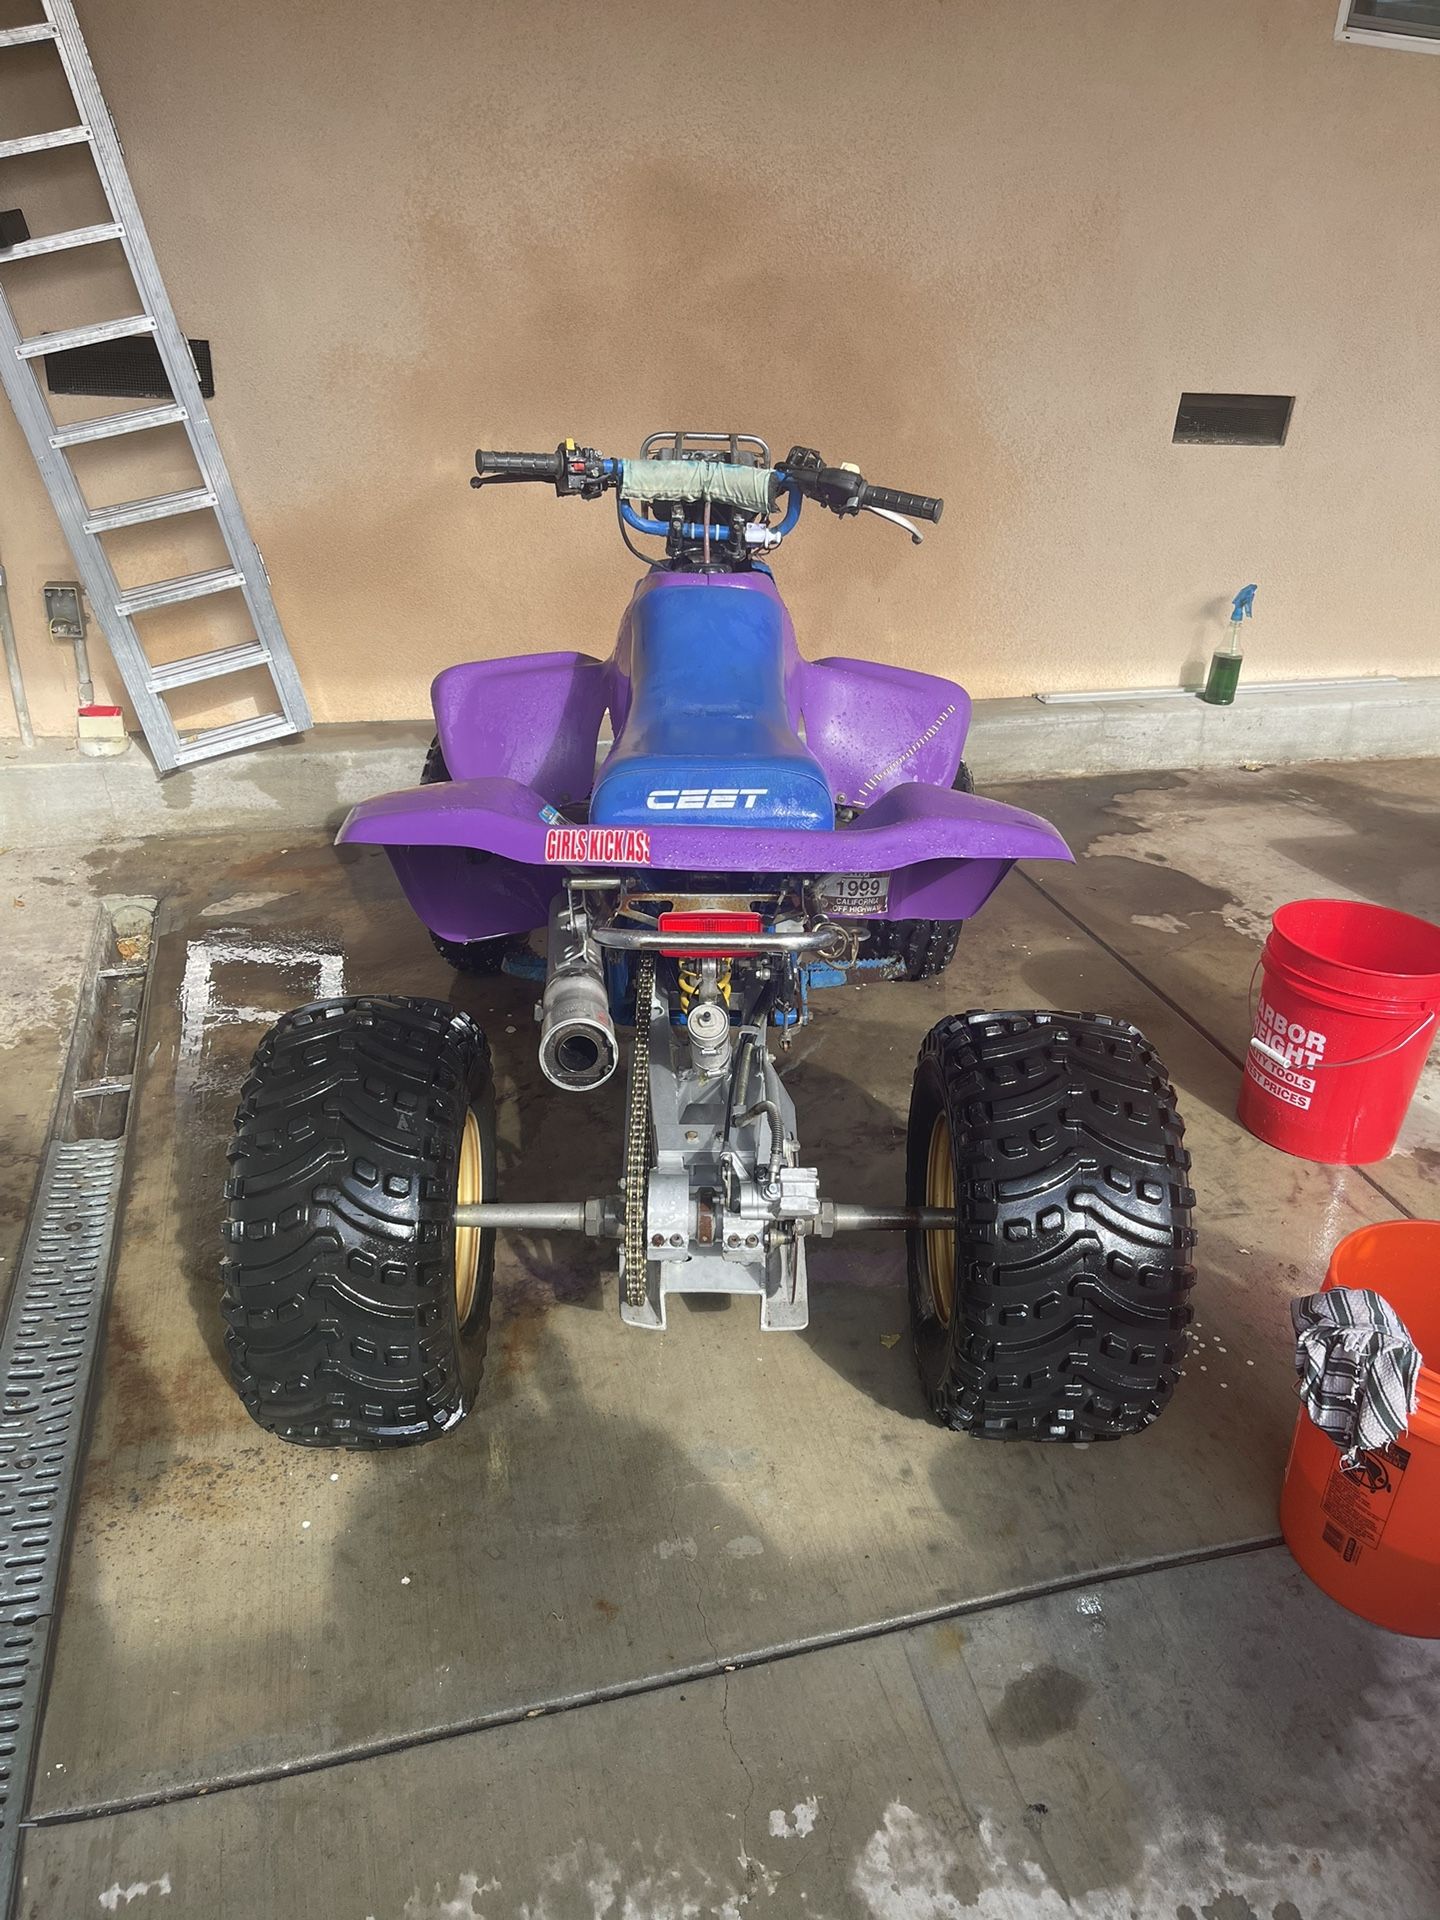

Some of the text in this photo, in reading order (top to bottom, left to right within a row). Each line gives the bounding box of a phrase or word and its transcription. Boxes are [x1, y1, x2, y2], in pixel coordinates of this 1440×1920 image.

[646, 788, 768, 810] CEET
[546, 830, 586, 862] GIRLS
[589, 830, 624, 862] KICK
[836, 880, 880, 896] 1999
[1270, 1064, 1312, 1090] TOOLS
[1263, 1080, 1308, 1107] PRICES
